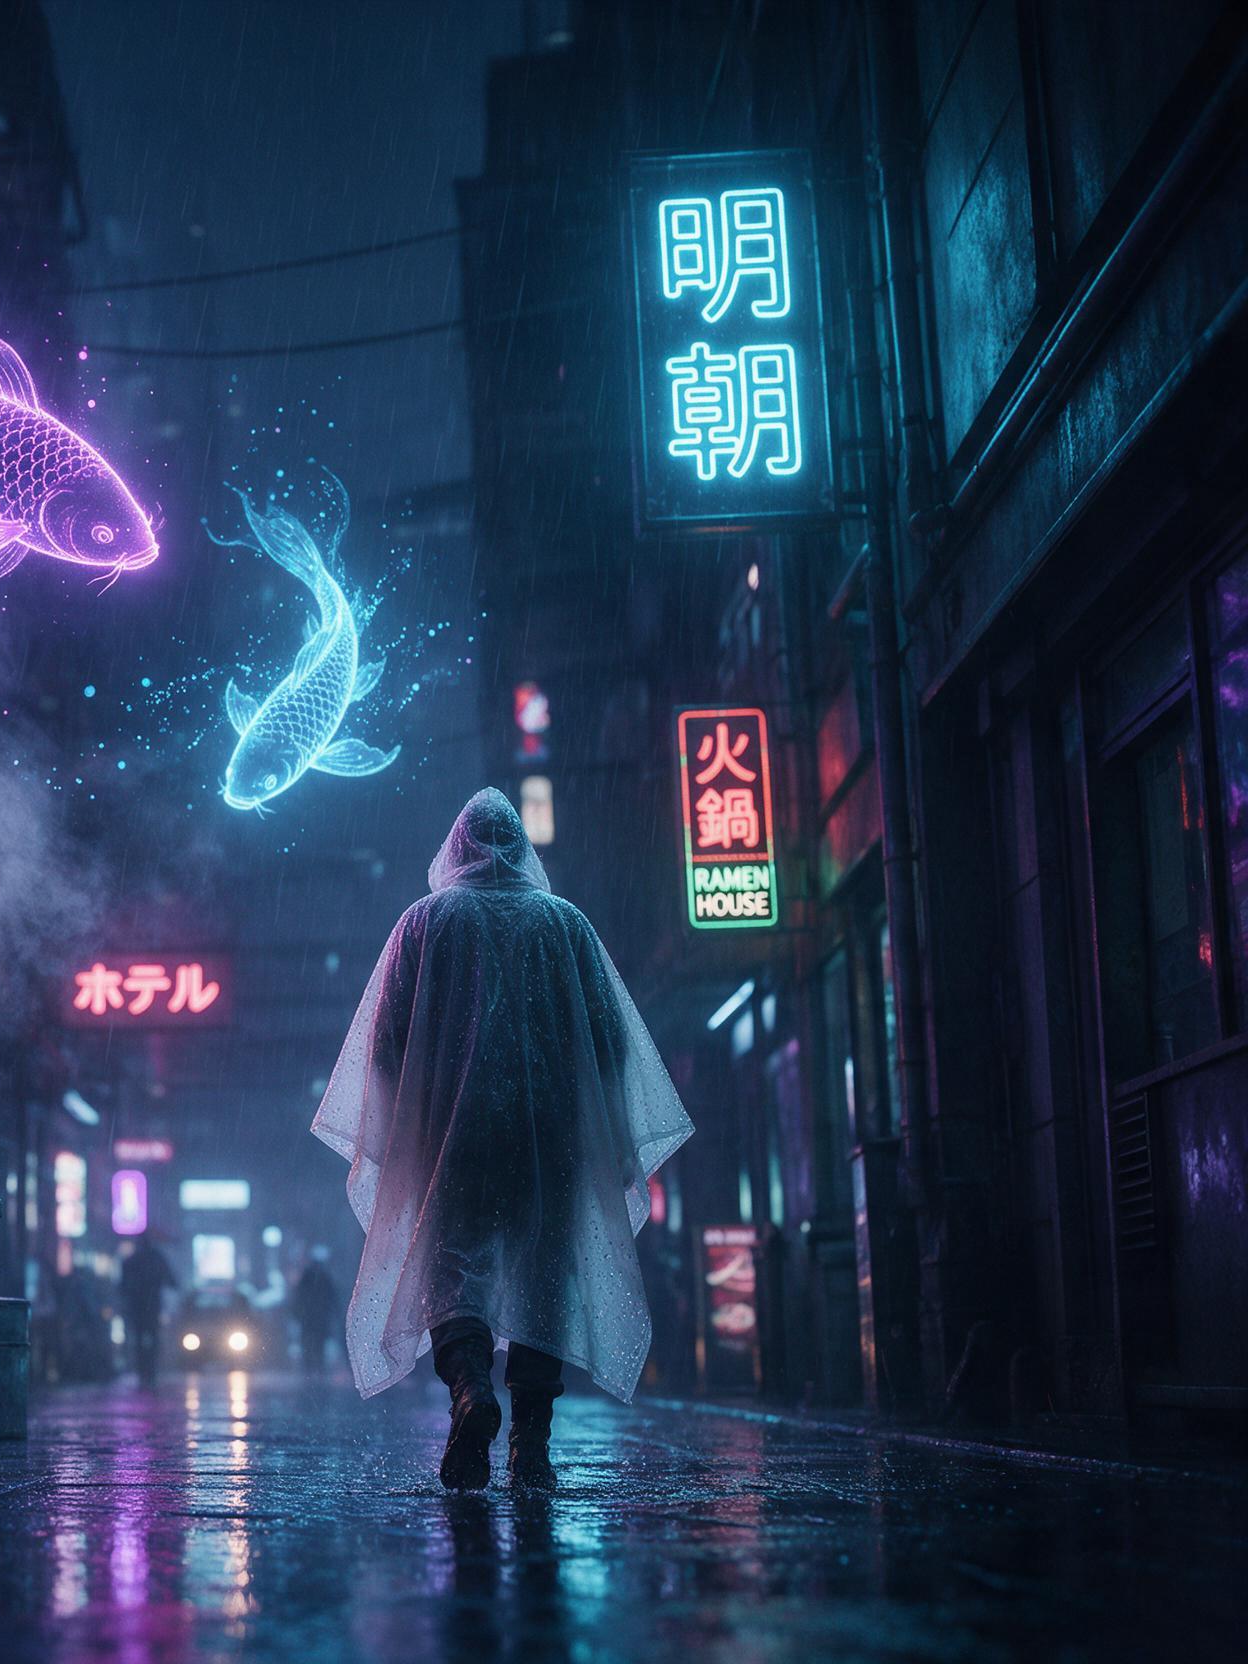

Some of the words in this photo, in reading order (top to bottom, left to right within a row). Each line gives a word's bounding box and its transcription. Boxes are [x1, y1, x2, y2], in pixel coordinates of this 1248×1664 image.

[658, 187, 802, 480] 明朝
[695, 722, 760, 848] 火鍋
[694, 865, 770, 892] RAMEN
[696, 891, 770, 918] HOUSE
[73, 962, 220, 1015] ホテル
